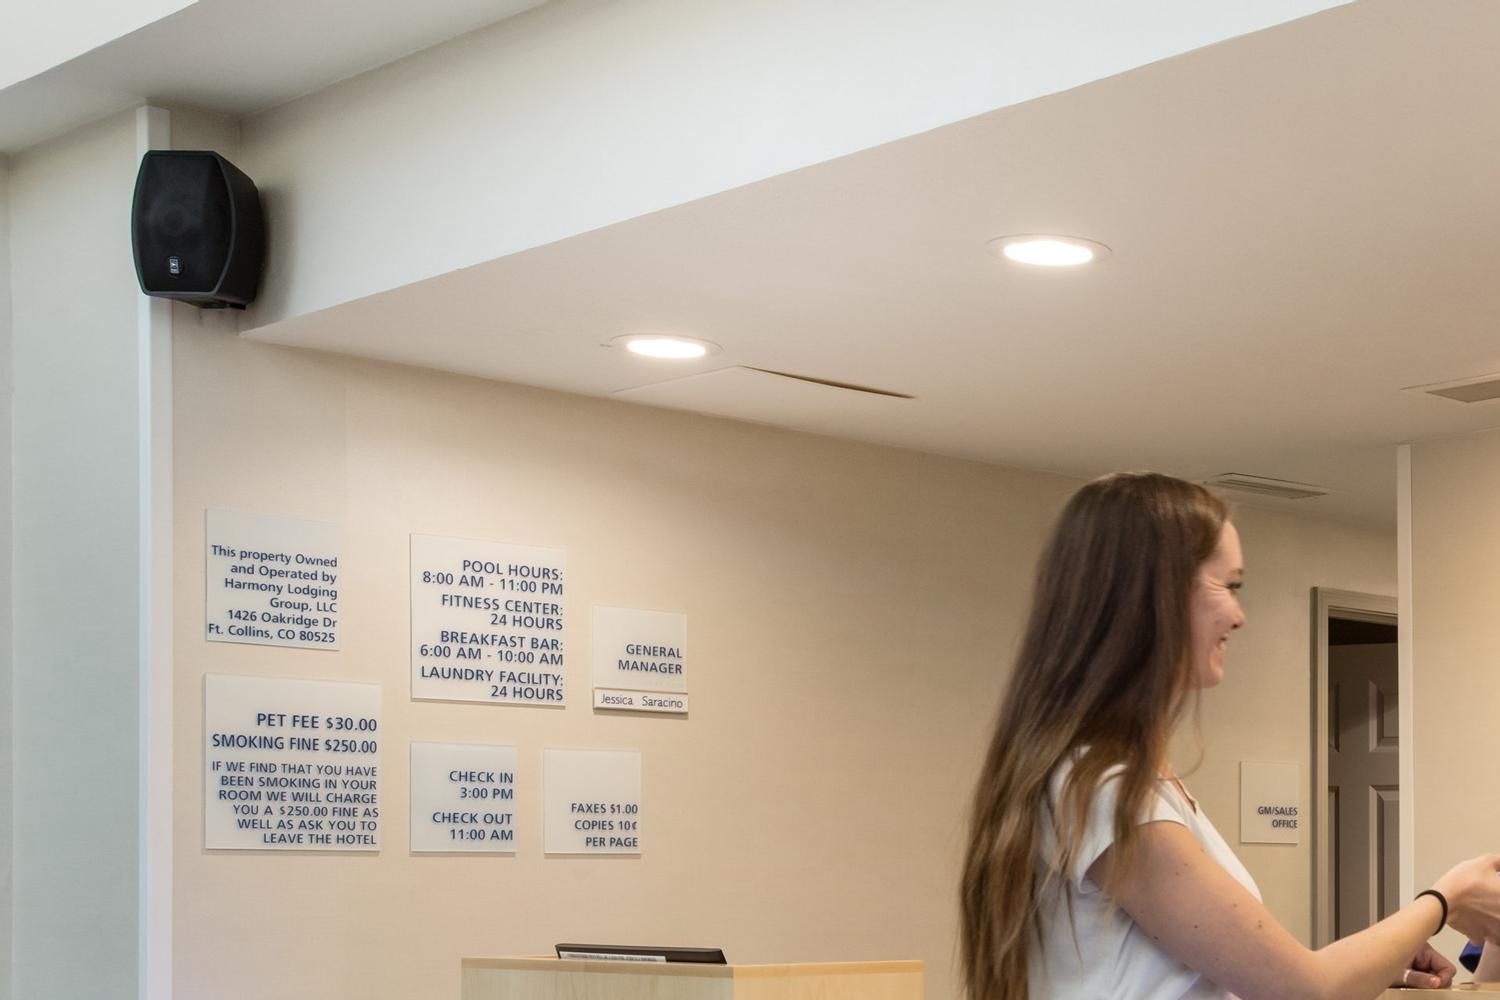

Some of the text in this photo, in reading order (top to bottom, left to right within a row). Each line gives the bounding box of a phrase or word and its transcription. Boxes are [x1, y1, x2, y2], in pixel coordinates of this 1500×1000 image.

[212, 545, 337, 567] This property Owned
[230, 565, 336, 584] and Operated by
[463, 560, 563, 580] POOL HOURS:
[224, 578, 337, 600] Harmony Lodging
[423, 571, 454, 585] 8:00
[459, 575, 484, 588] AM
[499, 579, 537, 592] 11:00
[542, 583, 563, 595] PM
[270, 598, 337, 612] Group, LLC
[441, 594, 563, 615] FITNESS CENTER:
[228, 610, 337, 628] 1426 Oakridge Dr
[490, 614, 563, 630] 24 HOURS
[208, 624, 335, 642] Ft. Collins, CO 80525
[441, 631, 563, 651] BREAKFAST BAR:
[420, 645, 451, 658] 6:00
[457, 647, 482, 660] AM
[497, 650, 534, 663] 10:00
[539, 654, 563, 665] AM
[626, 644, 682, 658] GENERAL
[618, 660, 682, 674] MANAGER
[421, 666, 563, 687] LAUNDRY FACILITY:
[491, 686, 563, 700] 24 HOURS
[601, 694, 683, 709] Jessica Saracino
[257, 713, 377, 731] PET FEE $30.00
[212, 734, 377, 753] SMOKING FINE $250.00
[212, 761, 377, 776] IF WE FIND THAT YOU HAVE
[221, 776, 377, 790] BEEN SMOKING IN YOUR
[449, 771, 513, 783] CHECK IN
[219, 790, 377, 804] ROOM WE WILL CHARGE
[460, 787, 513, 799] 3:00 PM
[233, 805, 379, 817] YOU A $250.00 FINE AS
[571, 803, 638, 814] FAXES $1.00
[1258, 806, 1298, 815] GM/SALES
[237, 819, 377, 831] WELL AS ASK YOU TO
[432, 812, 512, 824] CHECK OUT
[575, 820, 614, 830] COPIES
[1272, 819, 1298, 828] OFFICE
[264, 833, 376, 844] LEAVE THE HOTEL
[450, 829, 513, 840] 11:00 AM
[586, 837, 638, 848] PER PAGE
